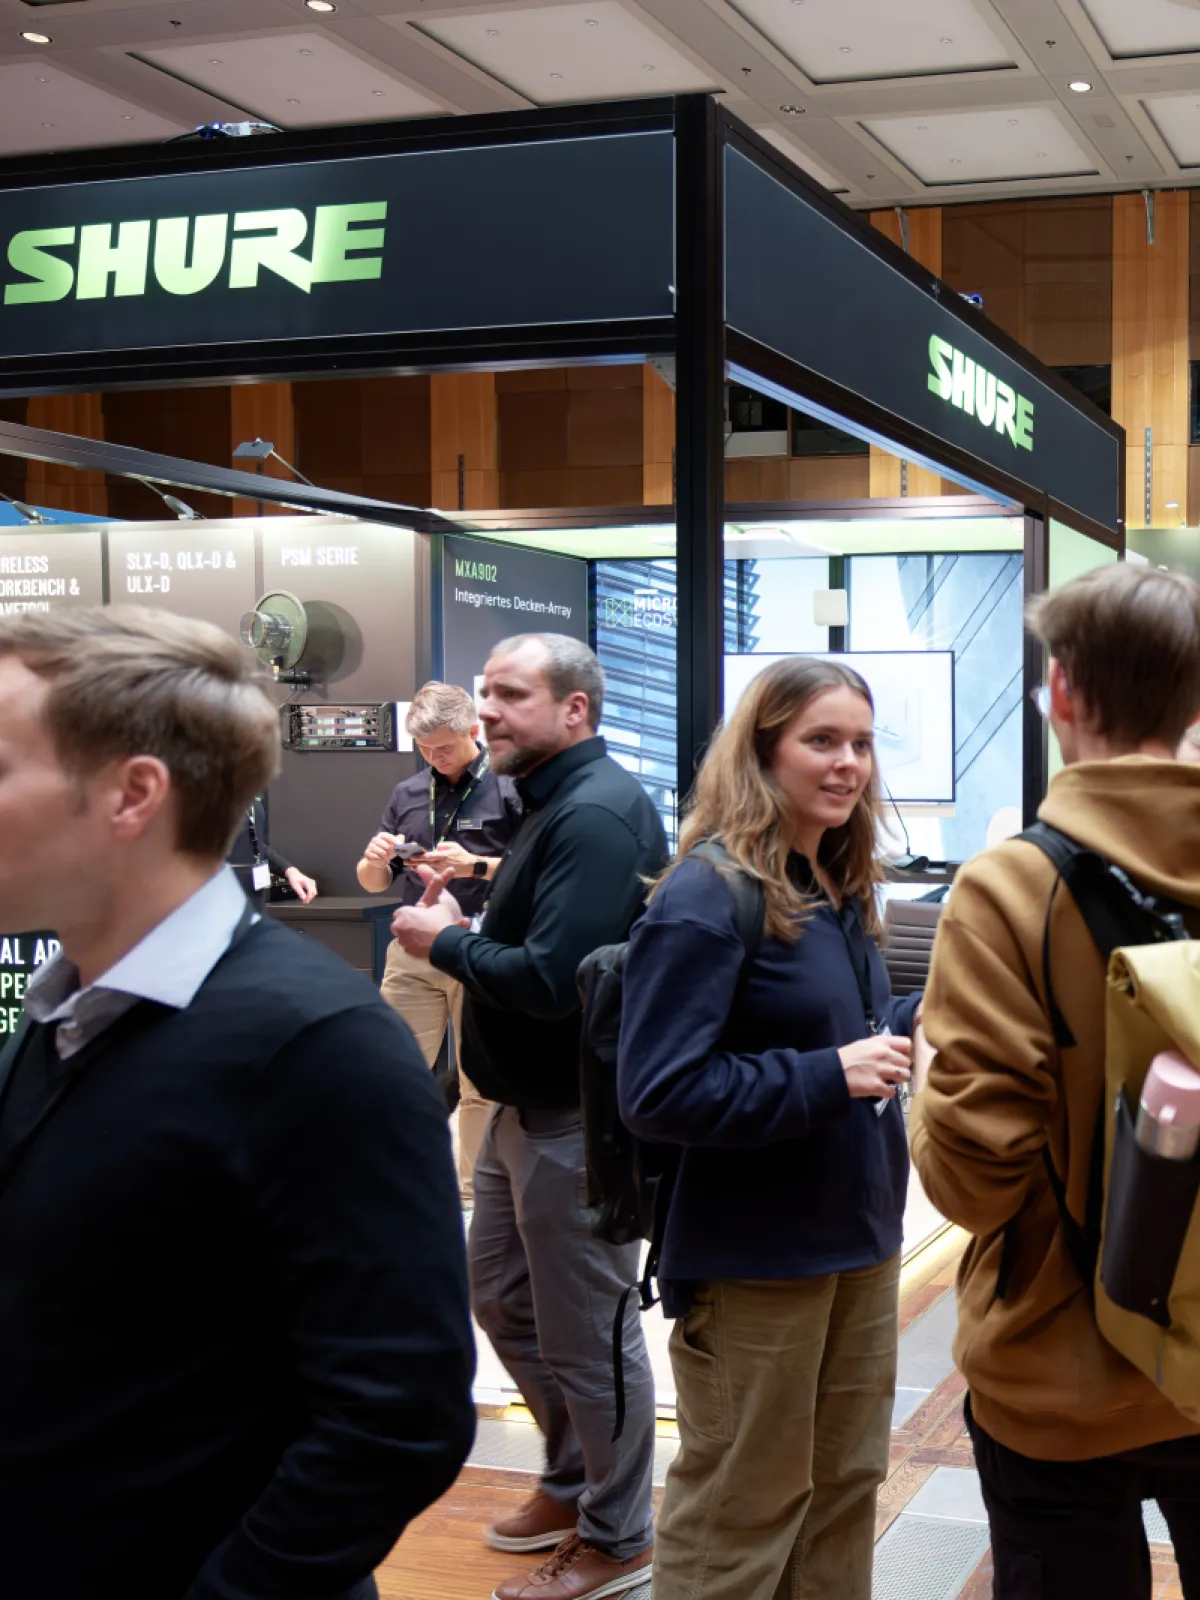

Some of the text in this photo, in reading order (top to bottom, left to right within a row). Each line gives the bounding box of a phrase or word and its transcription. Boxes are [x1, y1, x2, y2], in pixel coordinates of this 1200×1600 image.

[4, 201, 388, 305] SHURE
[927, 333, 1034, 452] SHURE
[126, 551, 236, 571] SLX-D, QLX-D &
[281, 546, 359, 566] PSM SERIE
[455, 559, 497, 583] MXA902
[69, 576, 80, 596] &
[126, 575, 170, 593] ULX-D
[455, 587, 572, 620] Integriertes Decken-Array
